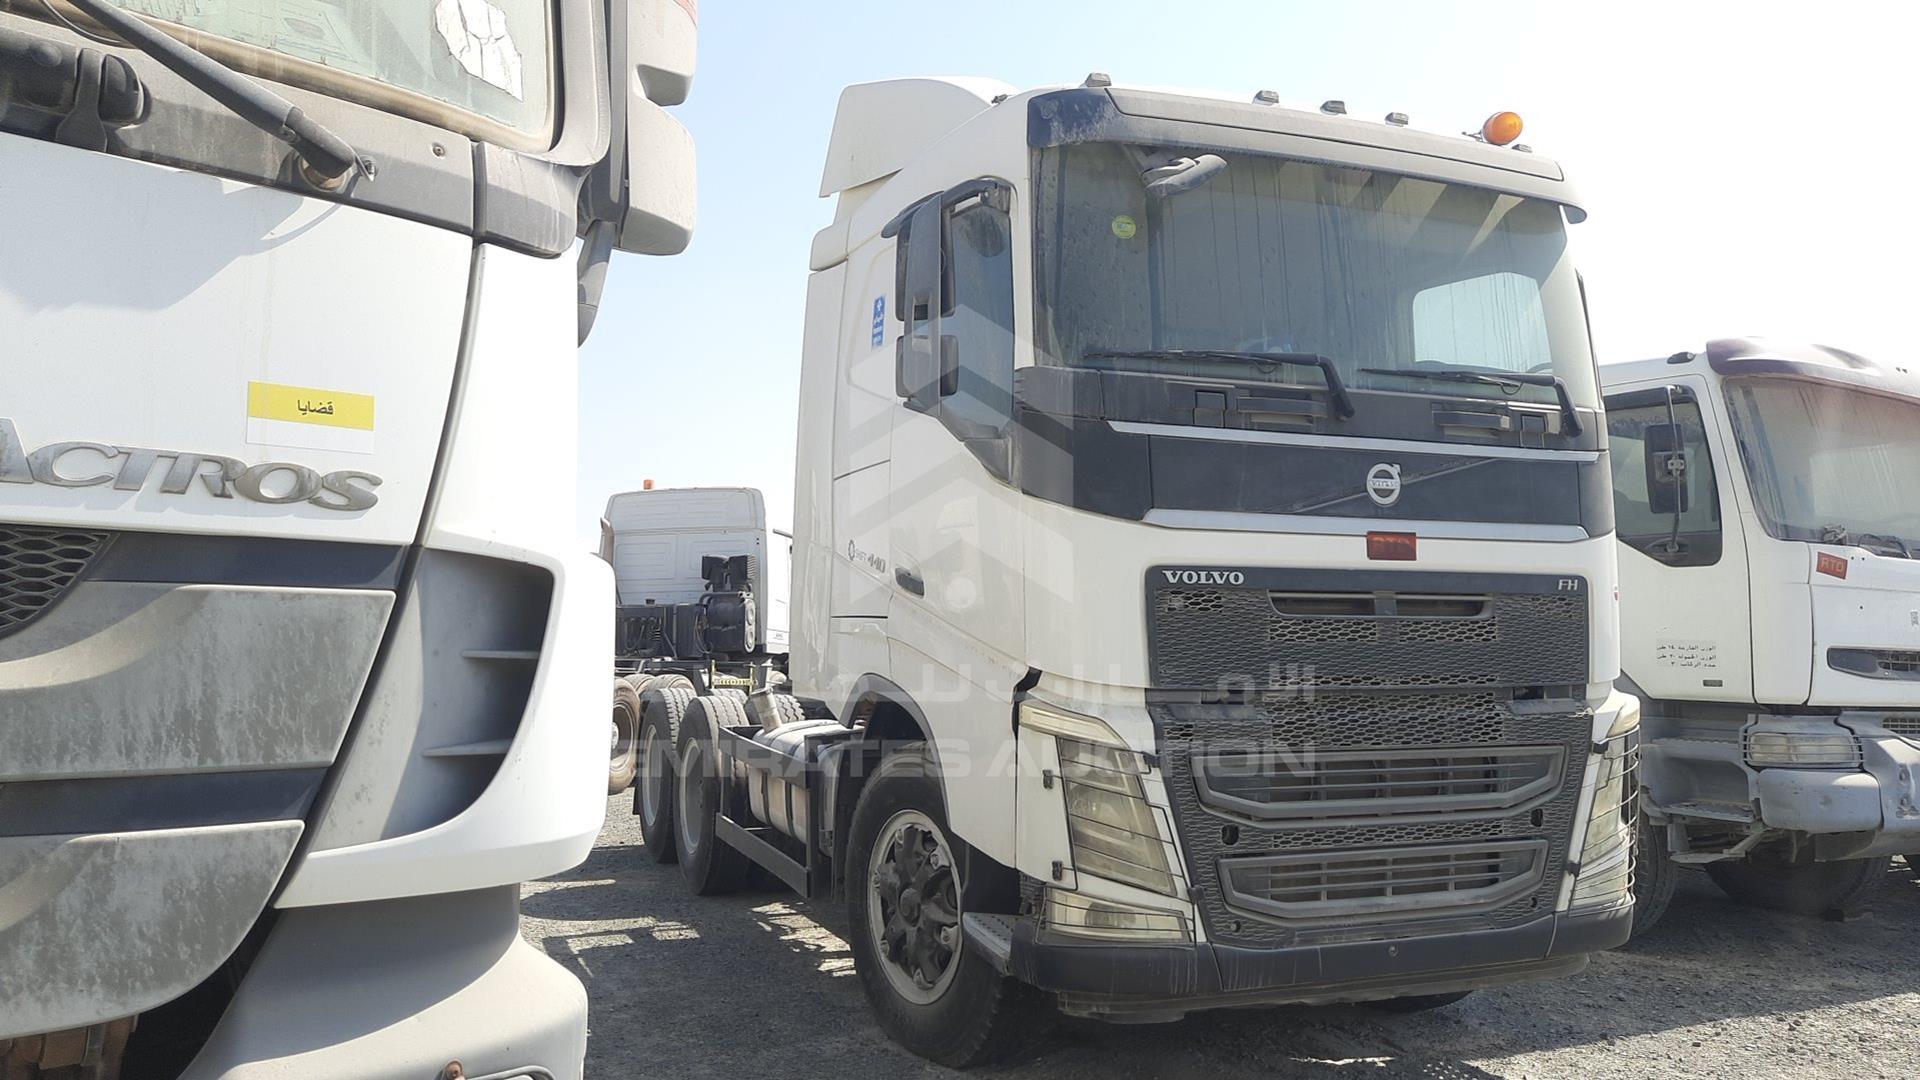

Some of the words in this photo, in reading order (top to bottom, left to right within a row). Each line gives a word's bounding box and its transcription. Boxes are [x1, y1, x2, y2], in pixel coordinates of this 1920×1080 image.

[297, 399, 334, 416] قضايا
[1162, 570, 1245, 585] VOLVO
[1558, 579, 1578, 590] FH
